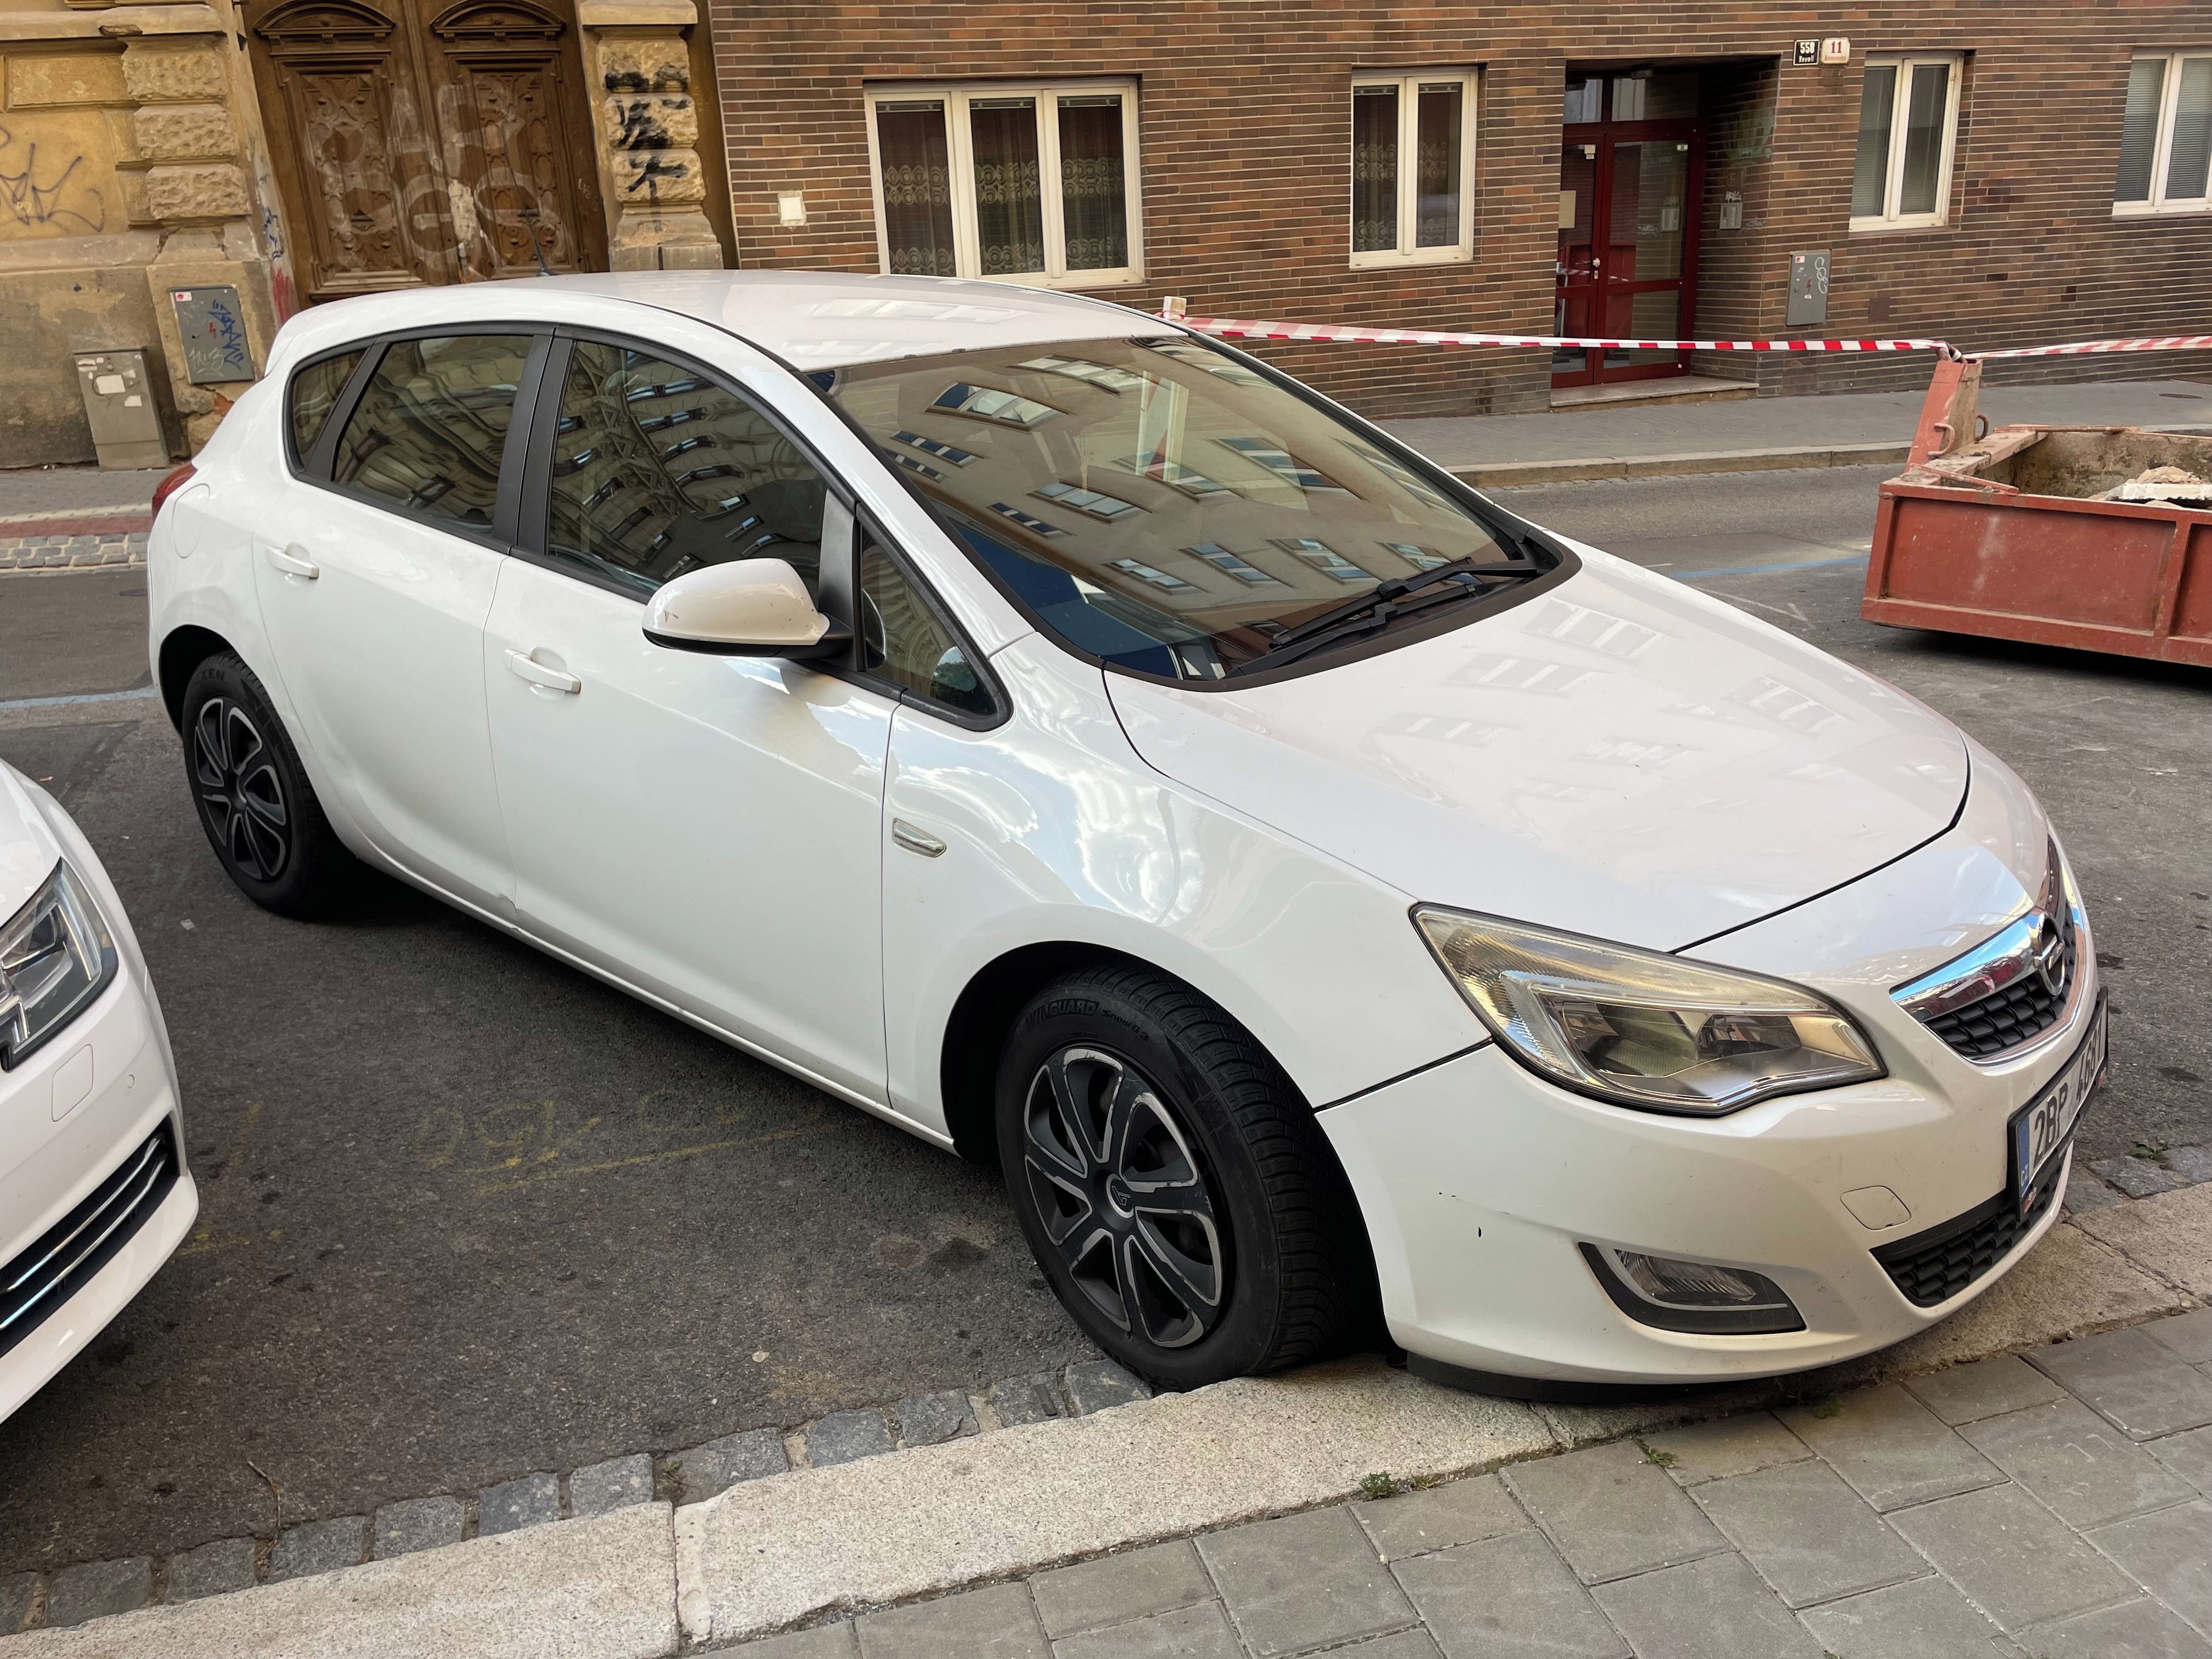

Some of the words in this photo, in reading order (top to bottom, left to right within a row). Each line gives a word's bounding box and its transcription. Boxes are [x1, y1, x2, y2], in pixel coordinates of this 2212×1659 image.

[1799, 41, 1815, 54] 558
[1831, 41, 1842, 54] 11
[2033, 1082, 2068, 1169] 2BP
[2021, 1165, 2029, 1187] CZ
